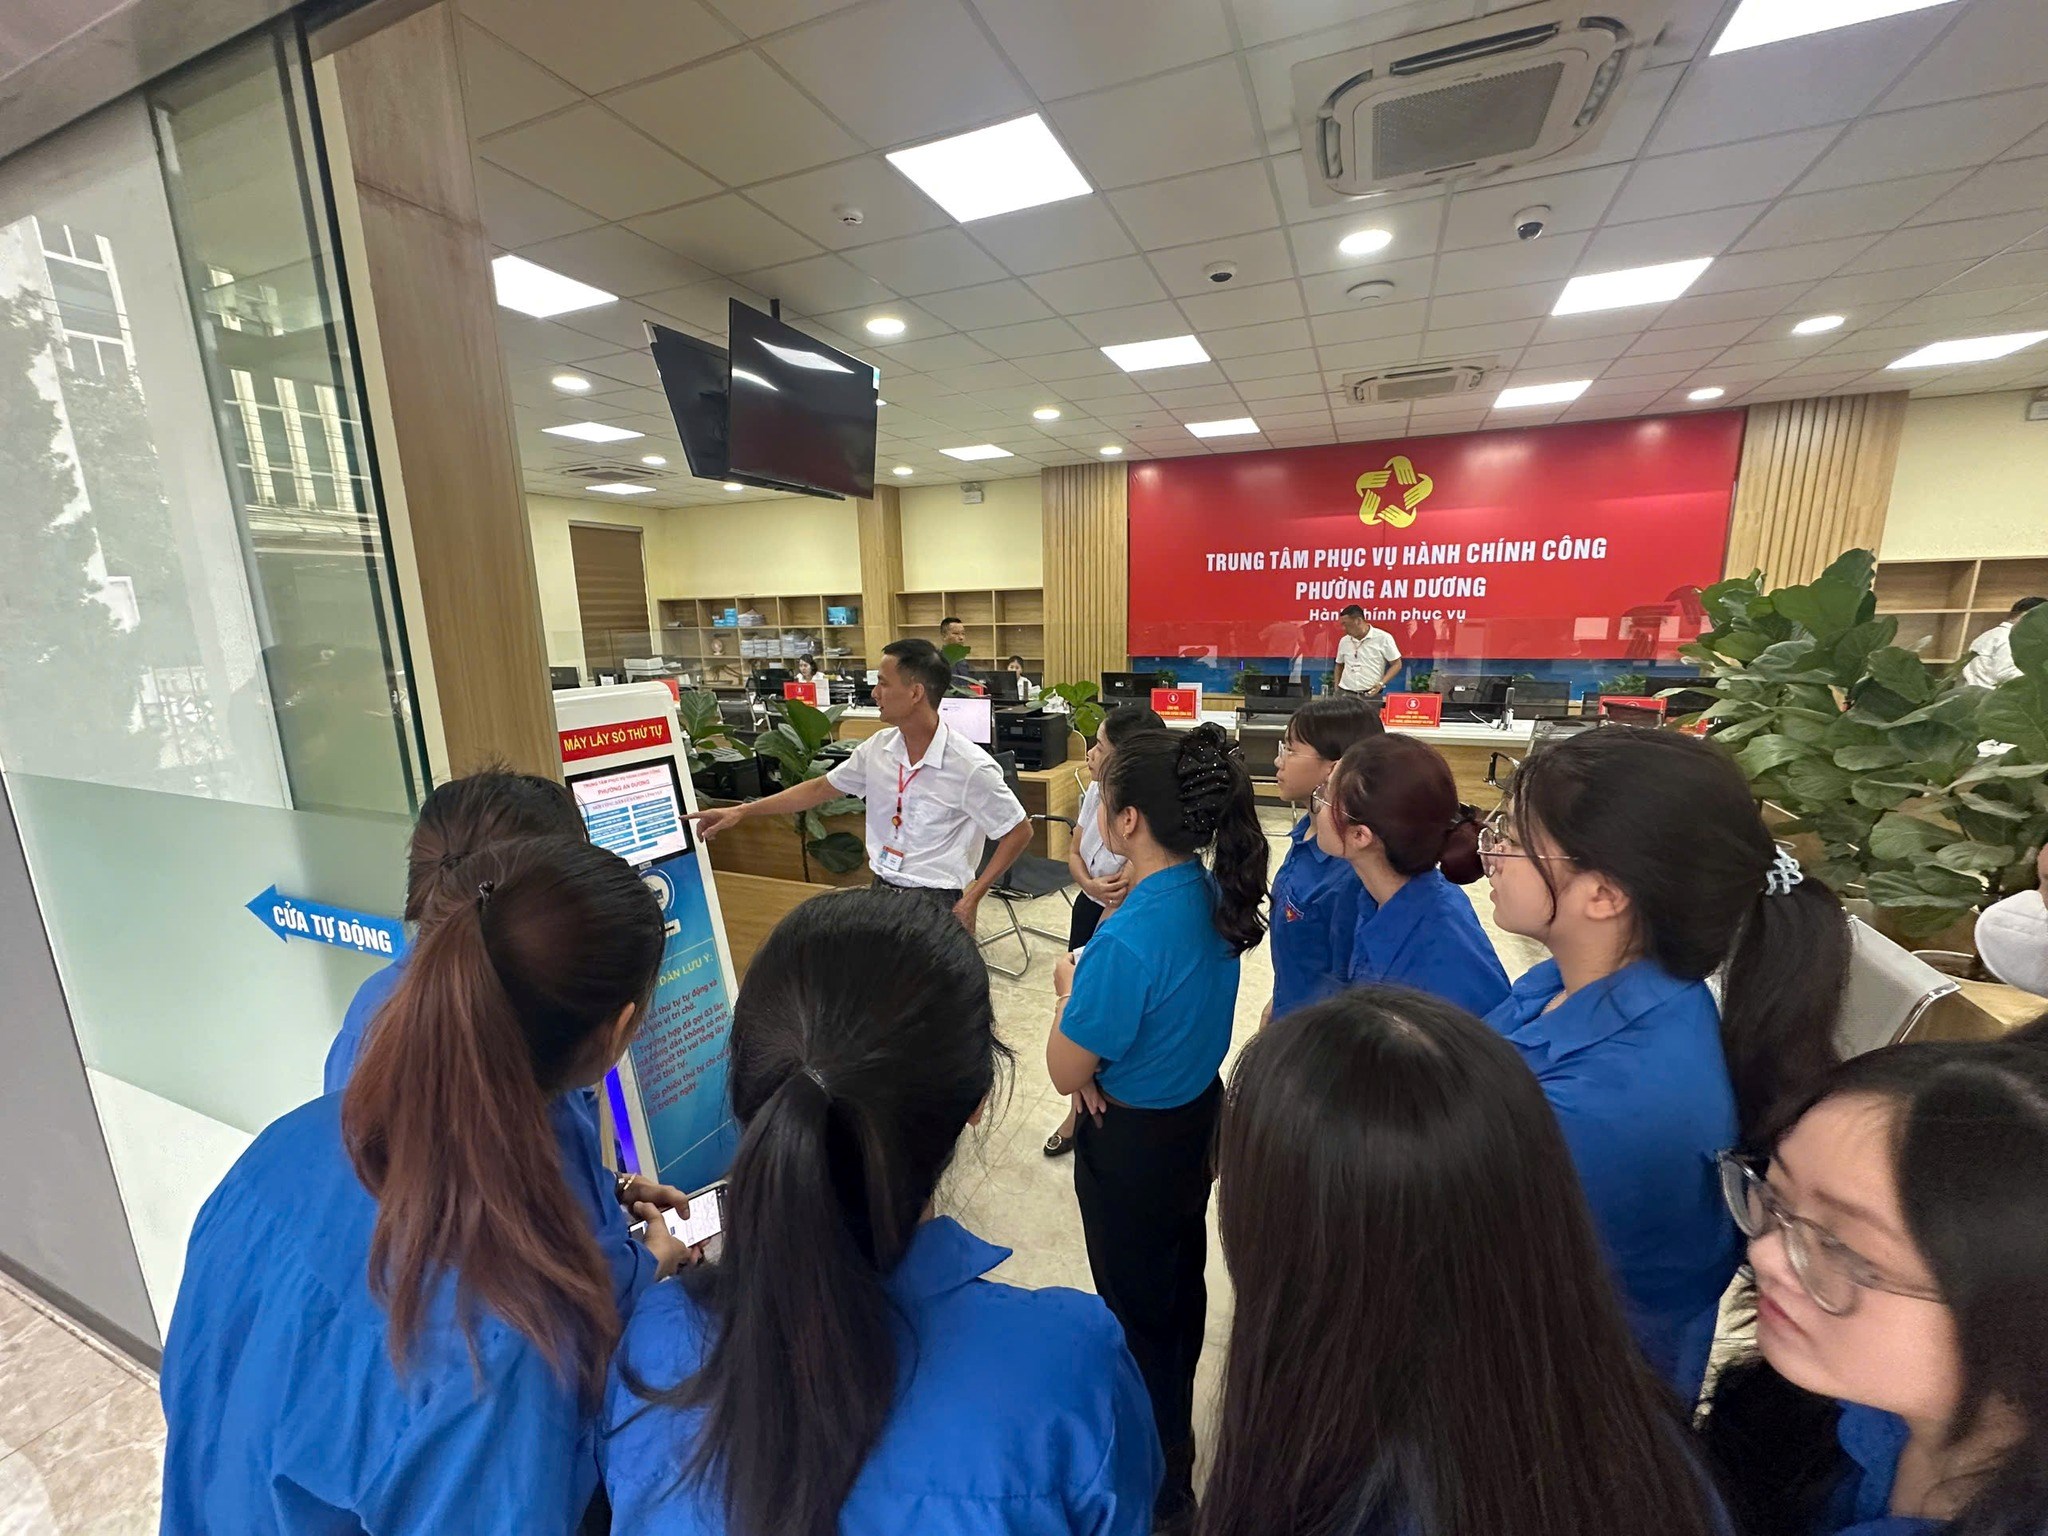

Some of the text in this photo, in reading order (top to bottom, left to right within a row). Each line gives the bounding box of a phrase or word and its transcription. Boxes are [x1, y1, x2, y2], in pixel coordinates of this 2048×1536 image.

[1206, 535, 1608, 572] TRUNG TÂM PHỤC VỤ HÀNH CHÍNH CÔNG
[1295, 576, 1487, 600] PHƯỜNG AN DƯƠNG
[1309, 607, 1466, 624] Hàn hính phục vụ
[564, 735, 587, 751] MÁY
[627, 725, 648, 741] THỨ
[649, 724, 663, 739] TỰ
[272, 901, 393, 954] CỬA TỰ ĐỘNG
[682, 958, 702, 975] LƯU
[692, 984, 709, 998] động
[667, 1026, 682, 1039] hợp
[684, 1025, 706, 1041] không
